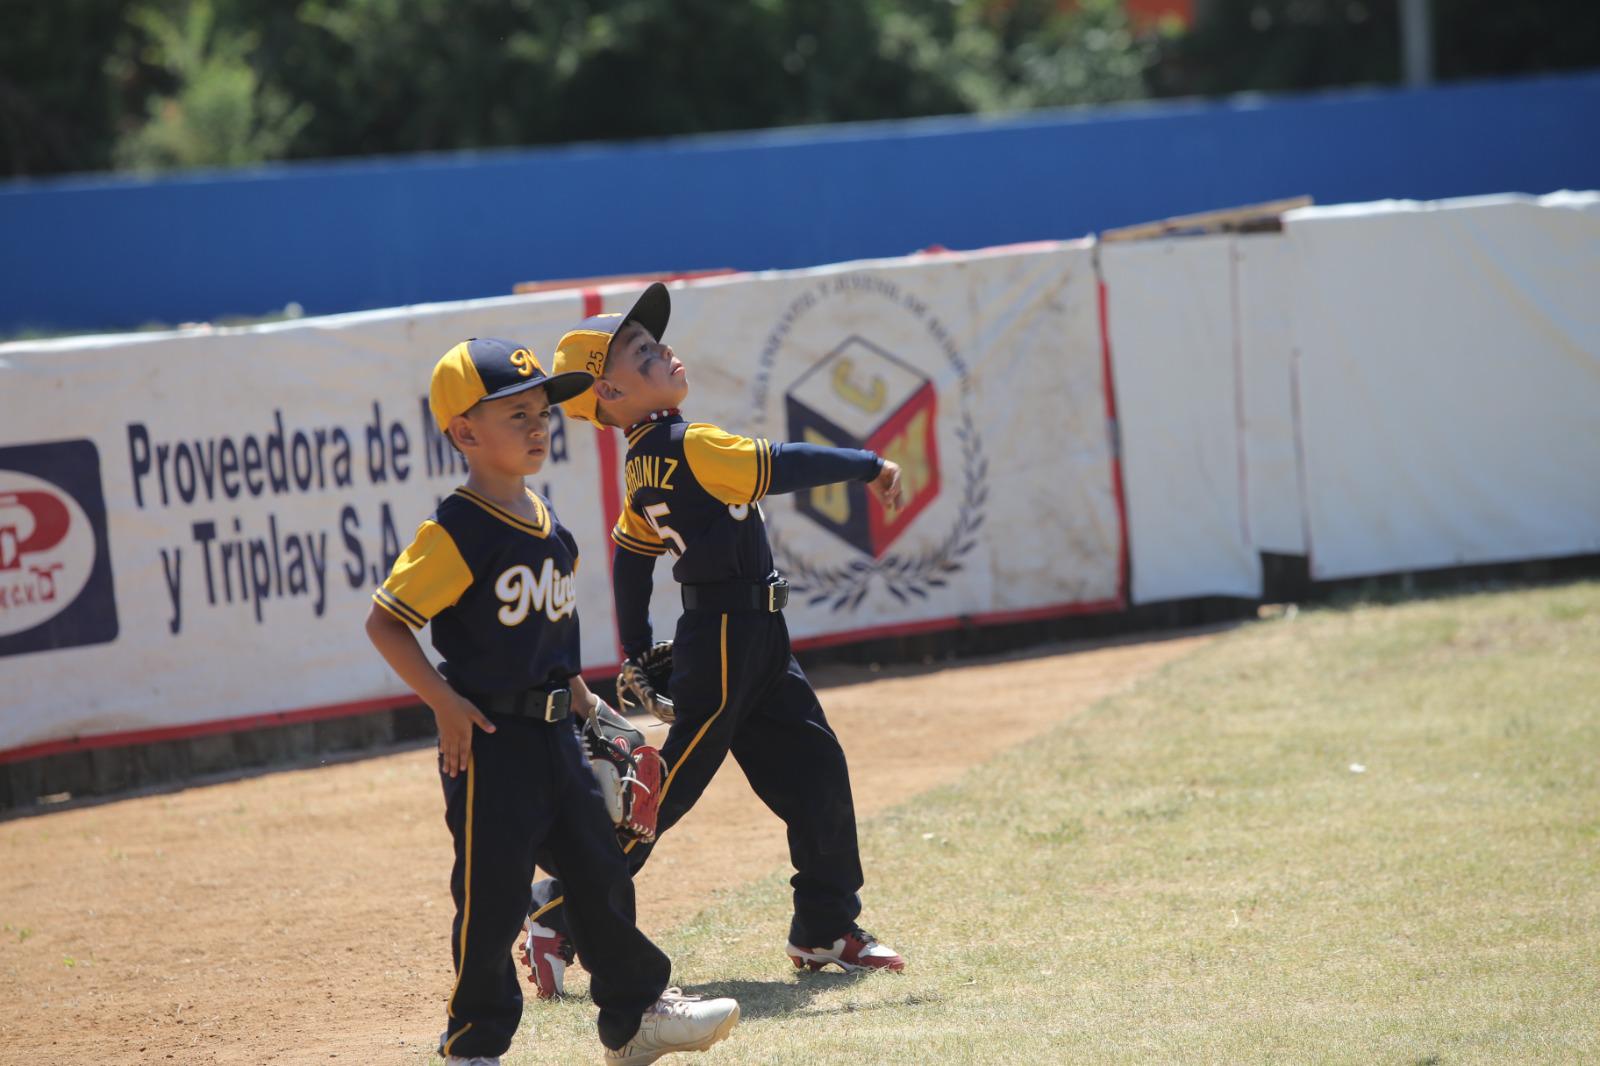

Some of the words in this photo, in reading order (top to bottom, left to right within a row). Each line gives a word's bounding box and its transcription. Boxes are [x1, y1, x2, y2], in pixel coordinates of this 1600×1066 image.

[586, 350, 604, 375] 25
[127, 408, 352, 508] Proveedora
[366, 400, 410, 482] de
[160, 548, 181, 635] y
[192, 514, 327, 624] Triplay
